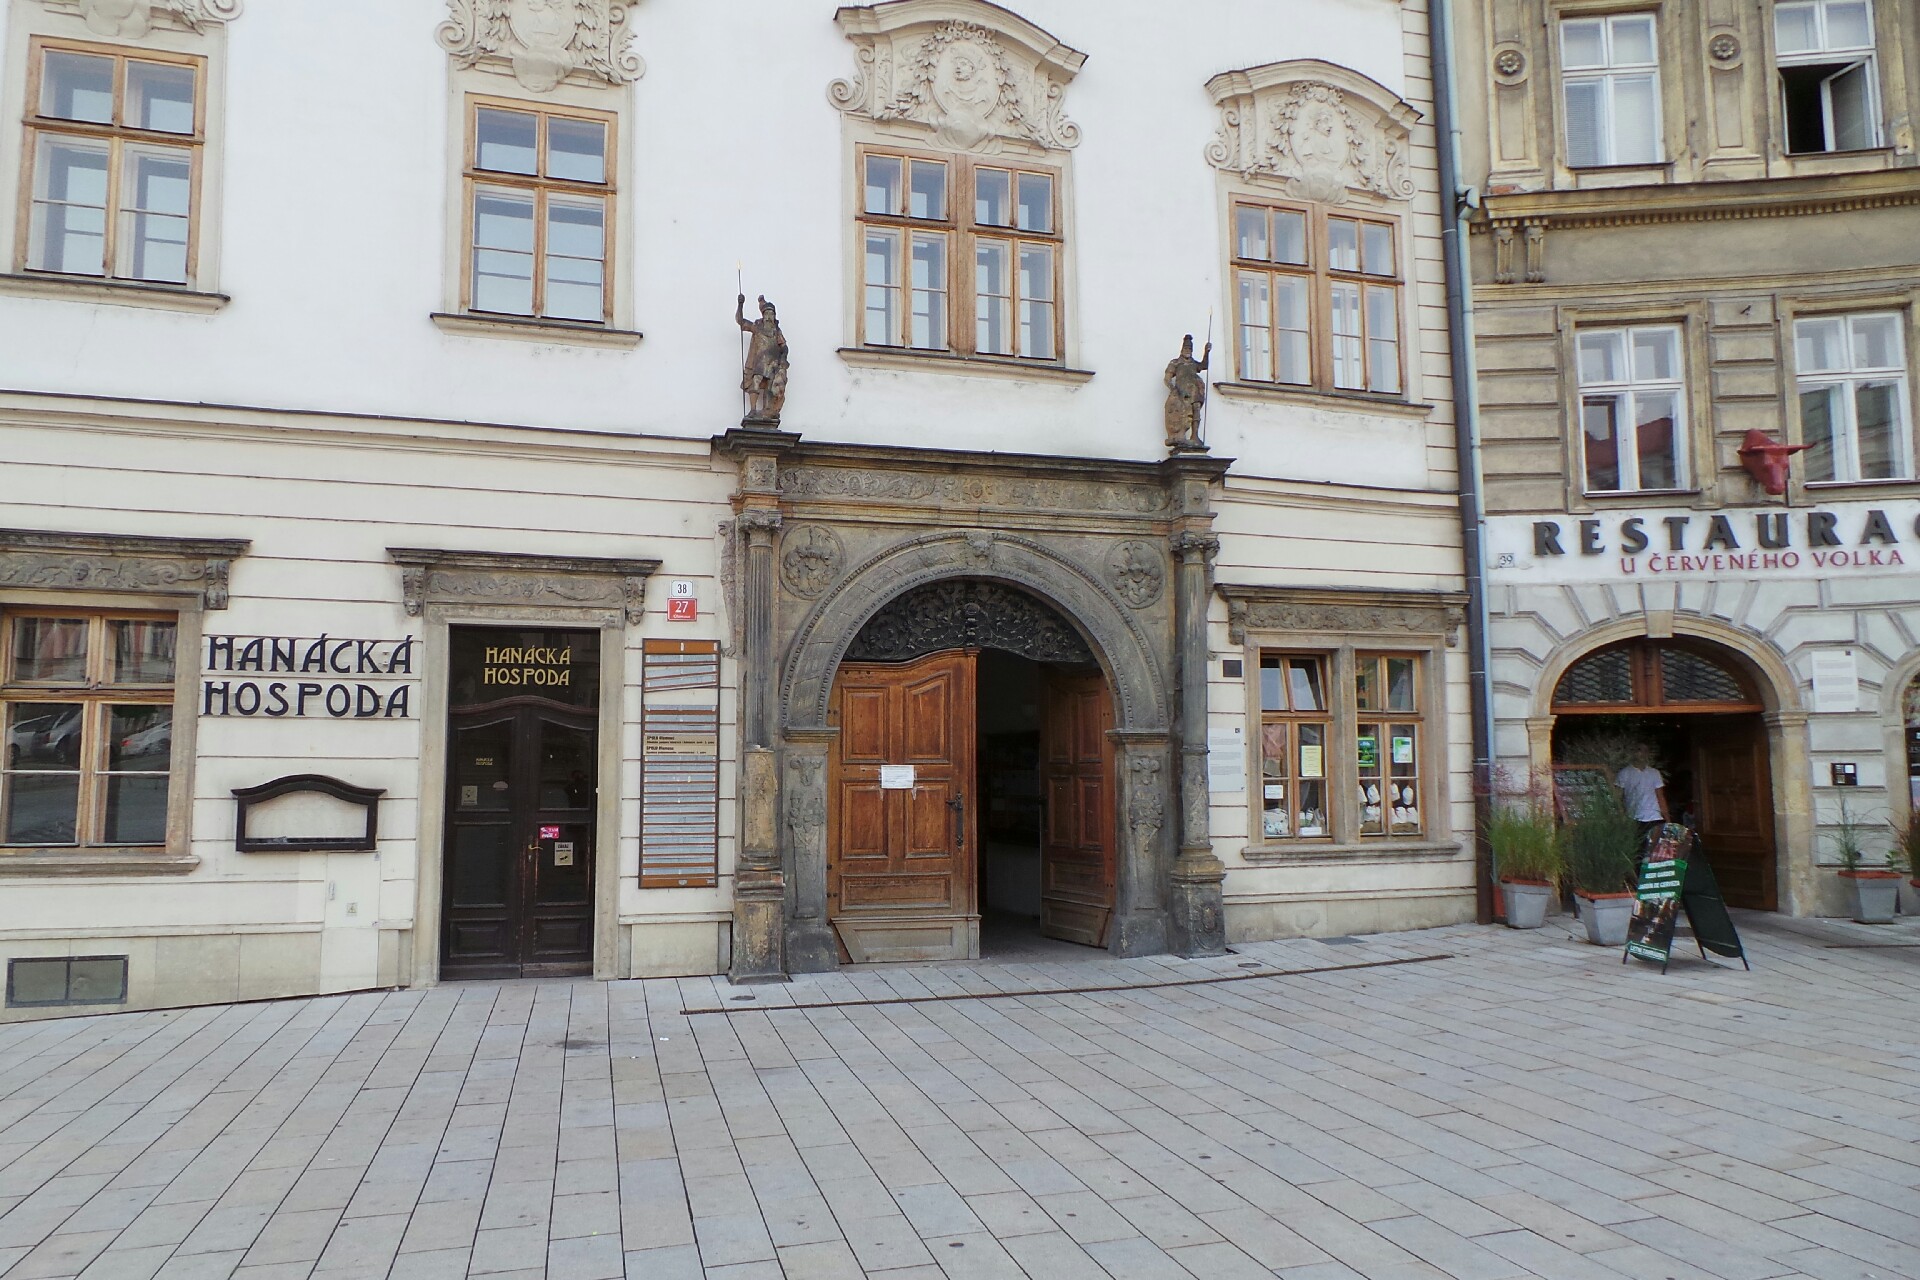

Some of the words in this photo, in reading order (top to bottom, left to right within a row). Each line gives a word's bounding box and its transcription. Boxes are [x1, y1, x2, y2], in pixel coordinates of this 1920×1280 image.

[1533, 509, 1920, 556] RESTAURA
[1499, 555, 1514, 567] 39
[1620, 557, 1636, 574] U
[1648, 549, 1800, 573] ČERVENÉHO
[1811, 549, 1905, 568] VOLKA
[677, 583, 688, 594] 38
[674, 601, 689, 613] 27
[207, 633, 414, 674] HANÁCKÁ
[484, 645, 571, 665] HANÁCKÁ
[484, 667, 570, 686] HOSPODA
[203, 681, 411, 718] HOSPODA
